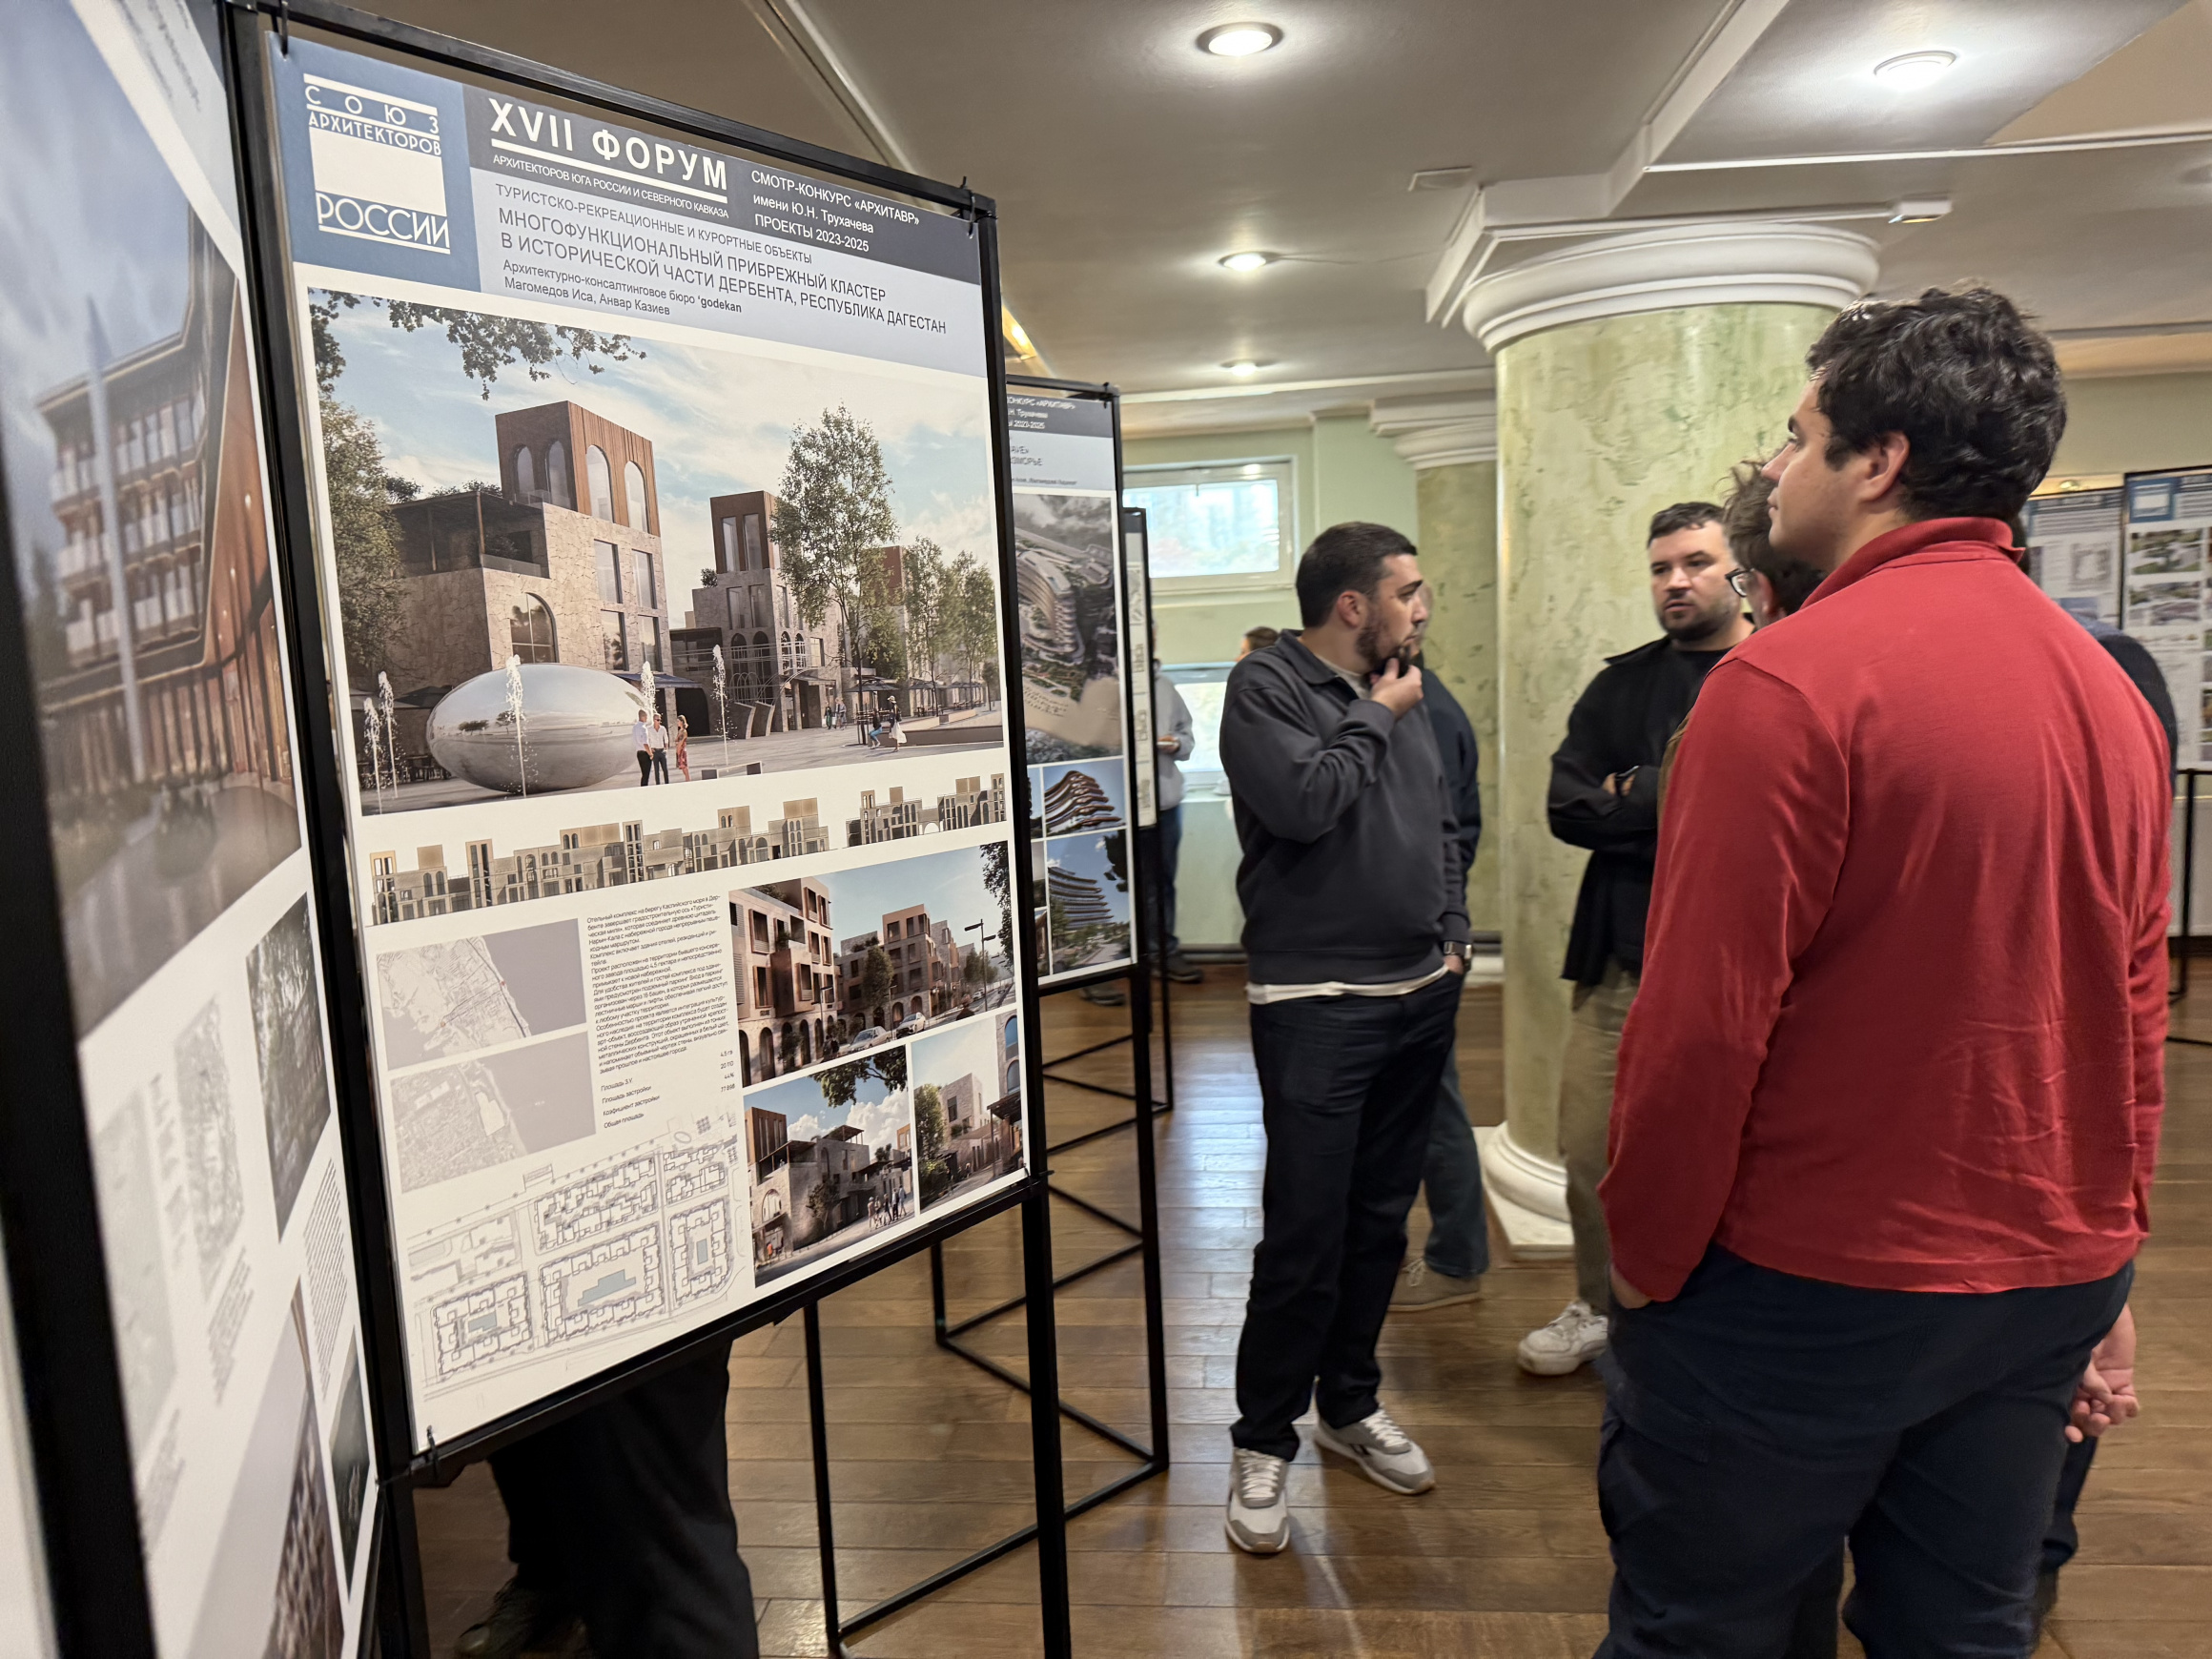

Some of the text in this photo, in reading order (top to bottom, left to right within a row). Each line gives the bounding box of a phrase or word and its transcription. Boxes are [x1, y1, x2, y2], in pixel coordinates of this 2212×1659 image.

[305, 85, 440, 133] СОЮЗ
[309, 112, 440, 155] АРХИТЕКТОРОВ
[489, 97, 727, 190] XVII ФОРУМ
[493, 154, 729, 219] АРХИТЕКТОРОВ ЮГА РОССИИ И СЕВЕРНОГО КАВКАЗА
[751, 170, 920, 226] СМОТР-КОНКУРС «АРХИТАВР»
[317, 194, 450, 248] РОССИИ
[496, 183, 812, 264] ТУРИСТСКО-РЕКРЕАЦИОННЫЕ И КУРОРТНЫЕ ОБЪЕКТЫ
[753, 195, 874, 235] имени Ю.Н. Трухачева
[755, 214, 870, 253] ПРОЕКТЫ 2023-2025
[499, 208, 887, 302] МНОГОФУНКЦИОНАЛЬНЫЙ ПРИБРЕЖНЫЙ КЛАСТЕР
[502, 232, 947, 335] В ИСТОРИЧЕСКОЙ ЧАСТИ ДЕРБЕНТА, РЕСПУБЛИКА ДАГЕСТАН
[503, 259, 666, 301] Архитектурно-консалтинговое
[669, 289, 696, 308] бюро
[504, 276, 670, 316] Магомедов Иса, Анвар Казиев
